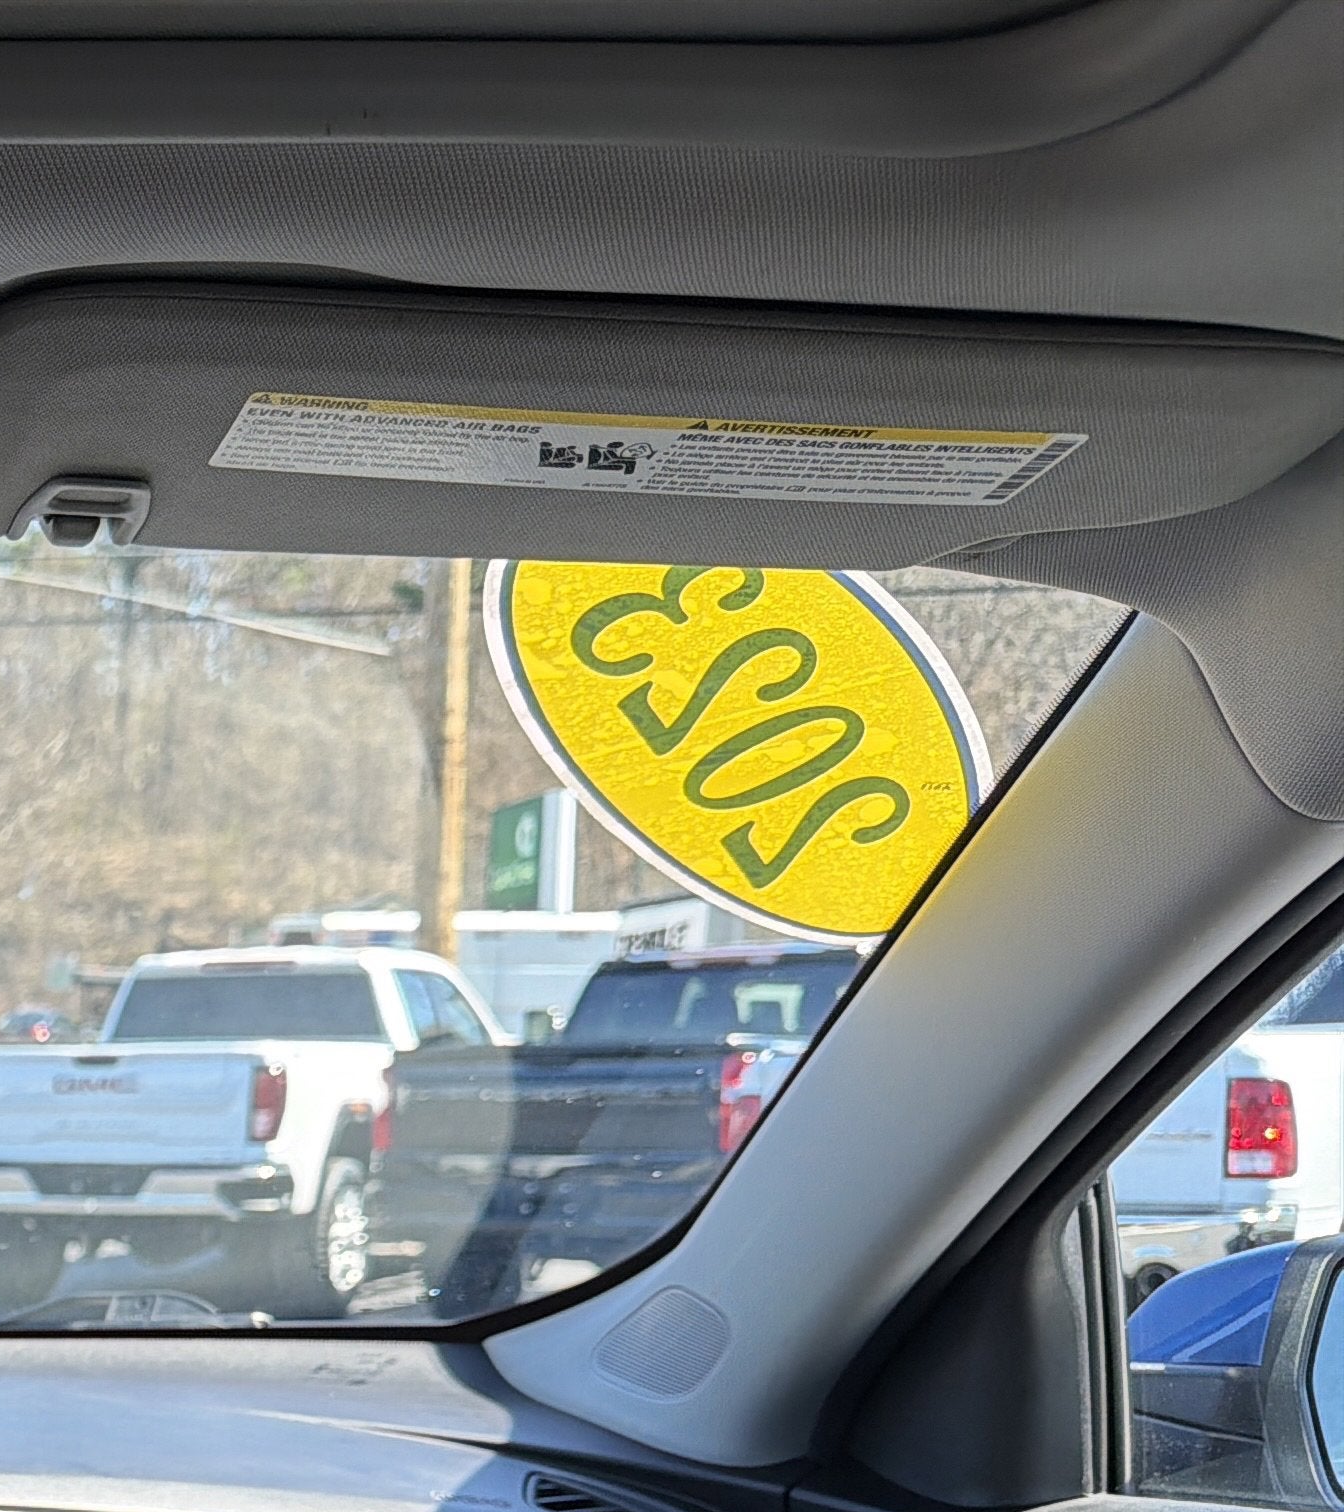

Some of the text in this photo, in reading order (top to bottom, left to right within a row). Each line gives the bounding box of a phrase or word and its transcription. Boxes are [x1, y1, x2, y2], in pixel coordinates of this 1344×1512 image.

[279, 396, 369, 410] WARNING
[247, 407, 294, 417] EVEN
[300, 411, 346, 422] WITH
[350, 414, 449, 428] ADVANCED
[715, 422, 879, 438] AVERTISSEMENT
[723, 436, 765, 445] AVEC
[765, 438, 796, 447] DES
[796, 439, 838, 449] SACS
[839, 441, 935, 453] GONFLABLES
